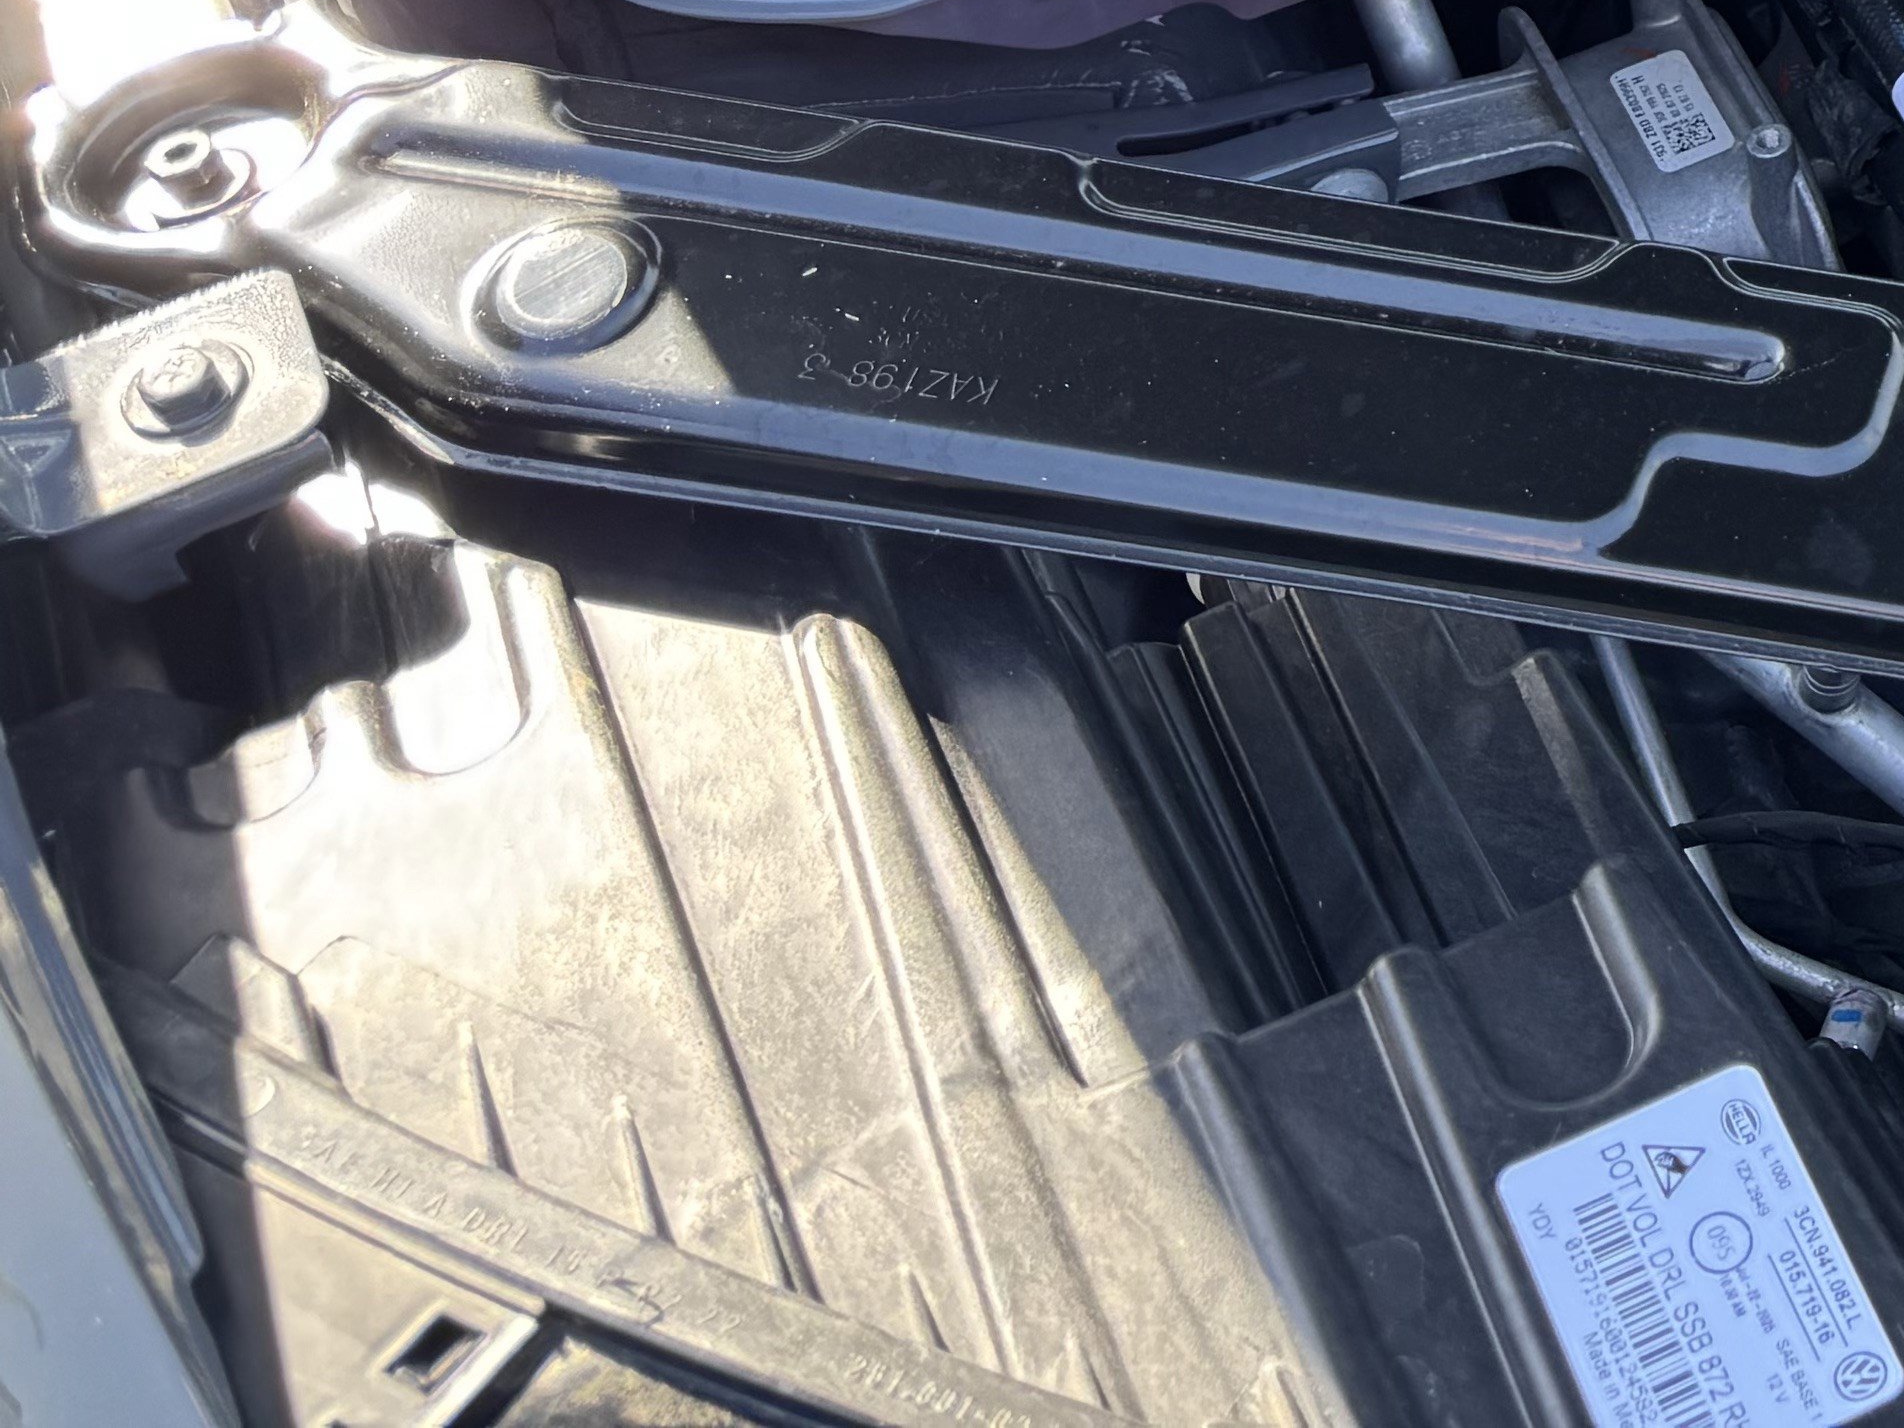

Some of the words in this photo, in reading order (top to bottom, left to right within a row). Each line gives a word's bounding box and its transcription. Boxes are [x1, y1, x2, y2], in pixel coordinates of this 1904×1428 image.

[1735, 1158, 1771, 1218] 1ZX.2949
[1769, 1159, 1792, 1191] 1000
[1599, 1140, 1643, 1196] DOT
[1622, 1192, 1664, 1247] VOL
[1648, 1246, 1685, 1302] DRL
[1673, 1301, 1714, 1354] SSB
[1696, 1354, 1736, 1403] 872
[1719, 1401, 1750, 1428] R
[1779, 1250, 1836, 1345] 015.719-16
[1793, 1205, 1862, 1331] 3CN.941.082.L
[1582, 1329, 1613, 1382] Made
[1603, 1382, 1622, 1402] in
[1775, 1337, 1800, 1370] SAE
[1790, 1369, 1819, 1411] BASE
